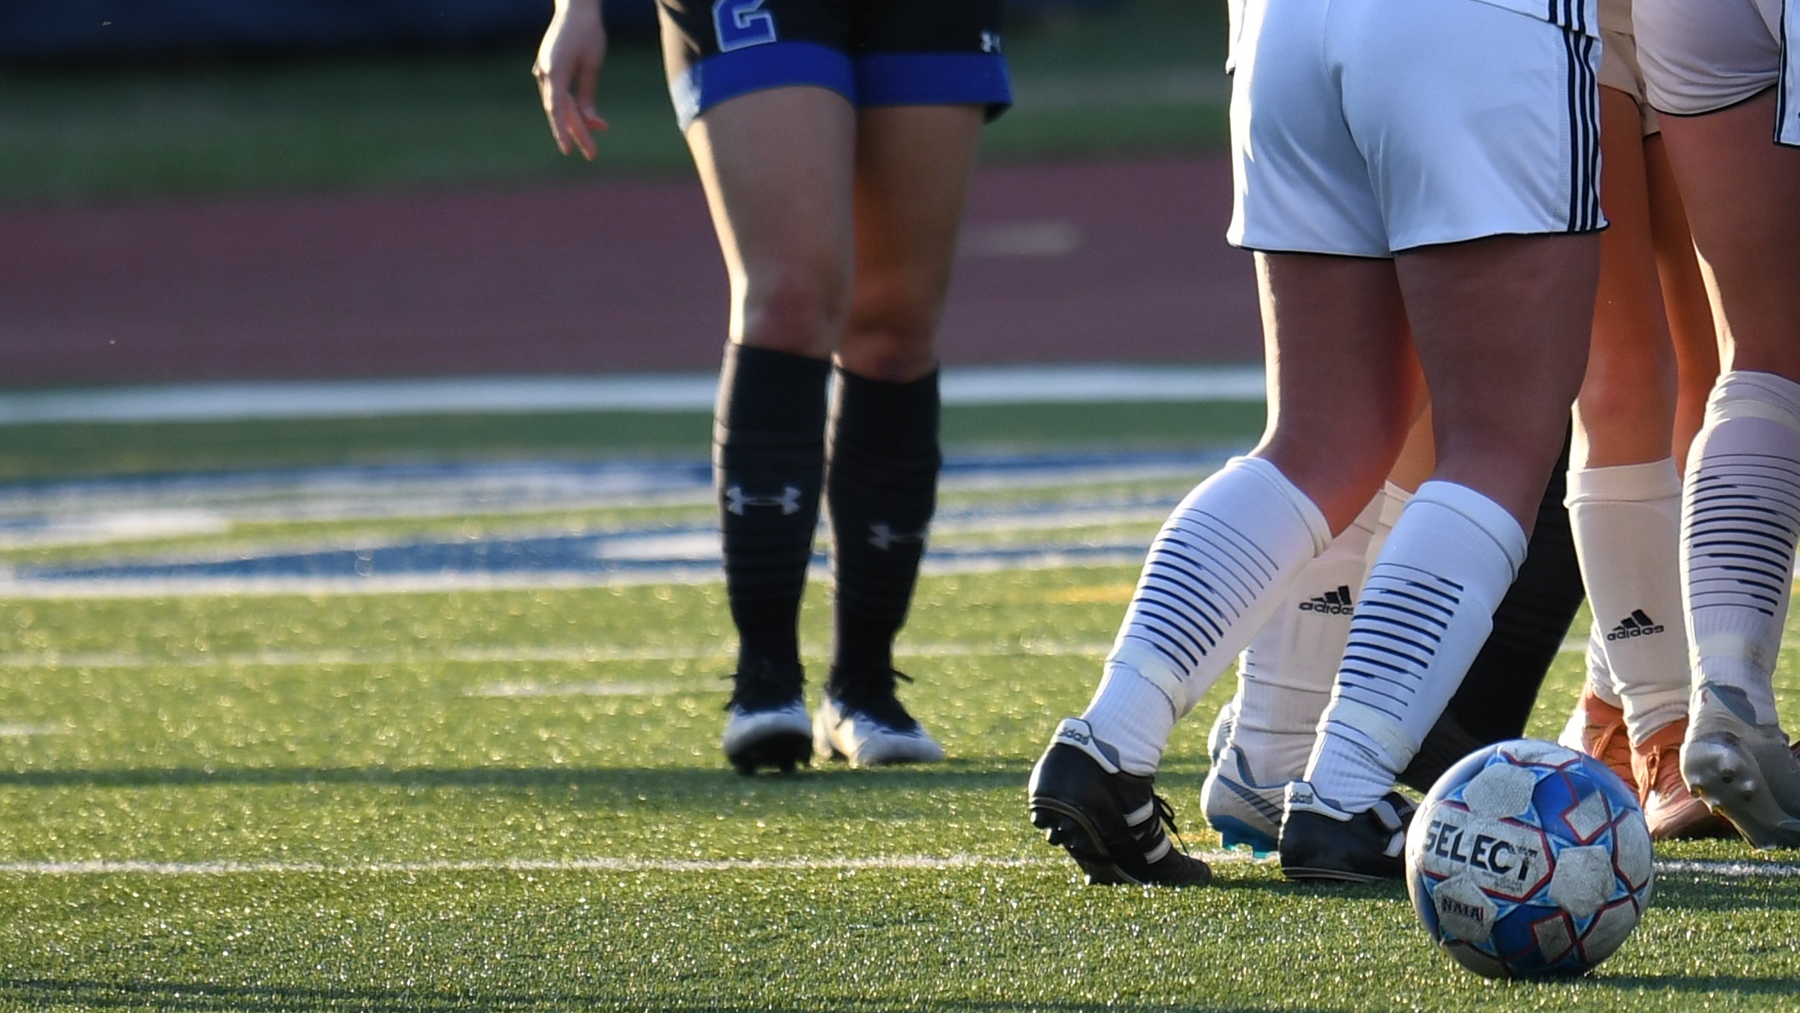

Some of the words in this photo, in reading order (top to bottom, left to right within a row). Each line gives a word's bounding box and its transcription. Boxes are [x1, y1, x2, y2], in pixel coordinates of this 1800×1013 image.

[1299, 600, 1354, 615] adidas
[1607, 624, 1665, 641] adidas
[1424, 819, 1538, 881] SELECT
[1441, 894, 1481, 921] NAIA
